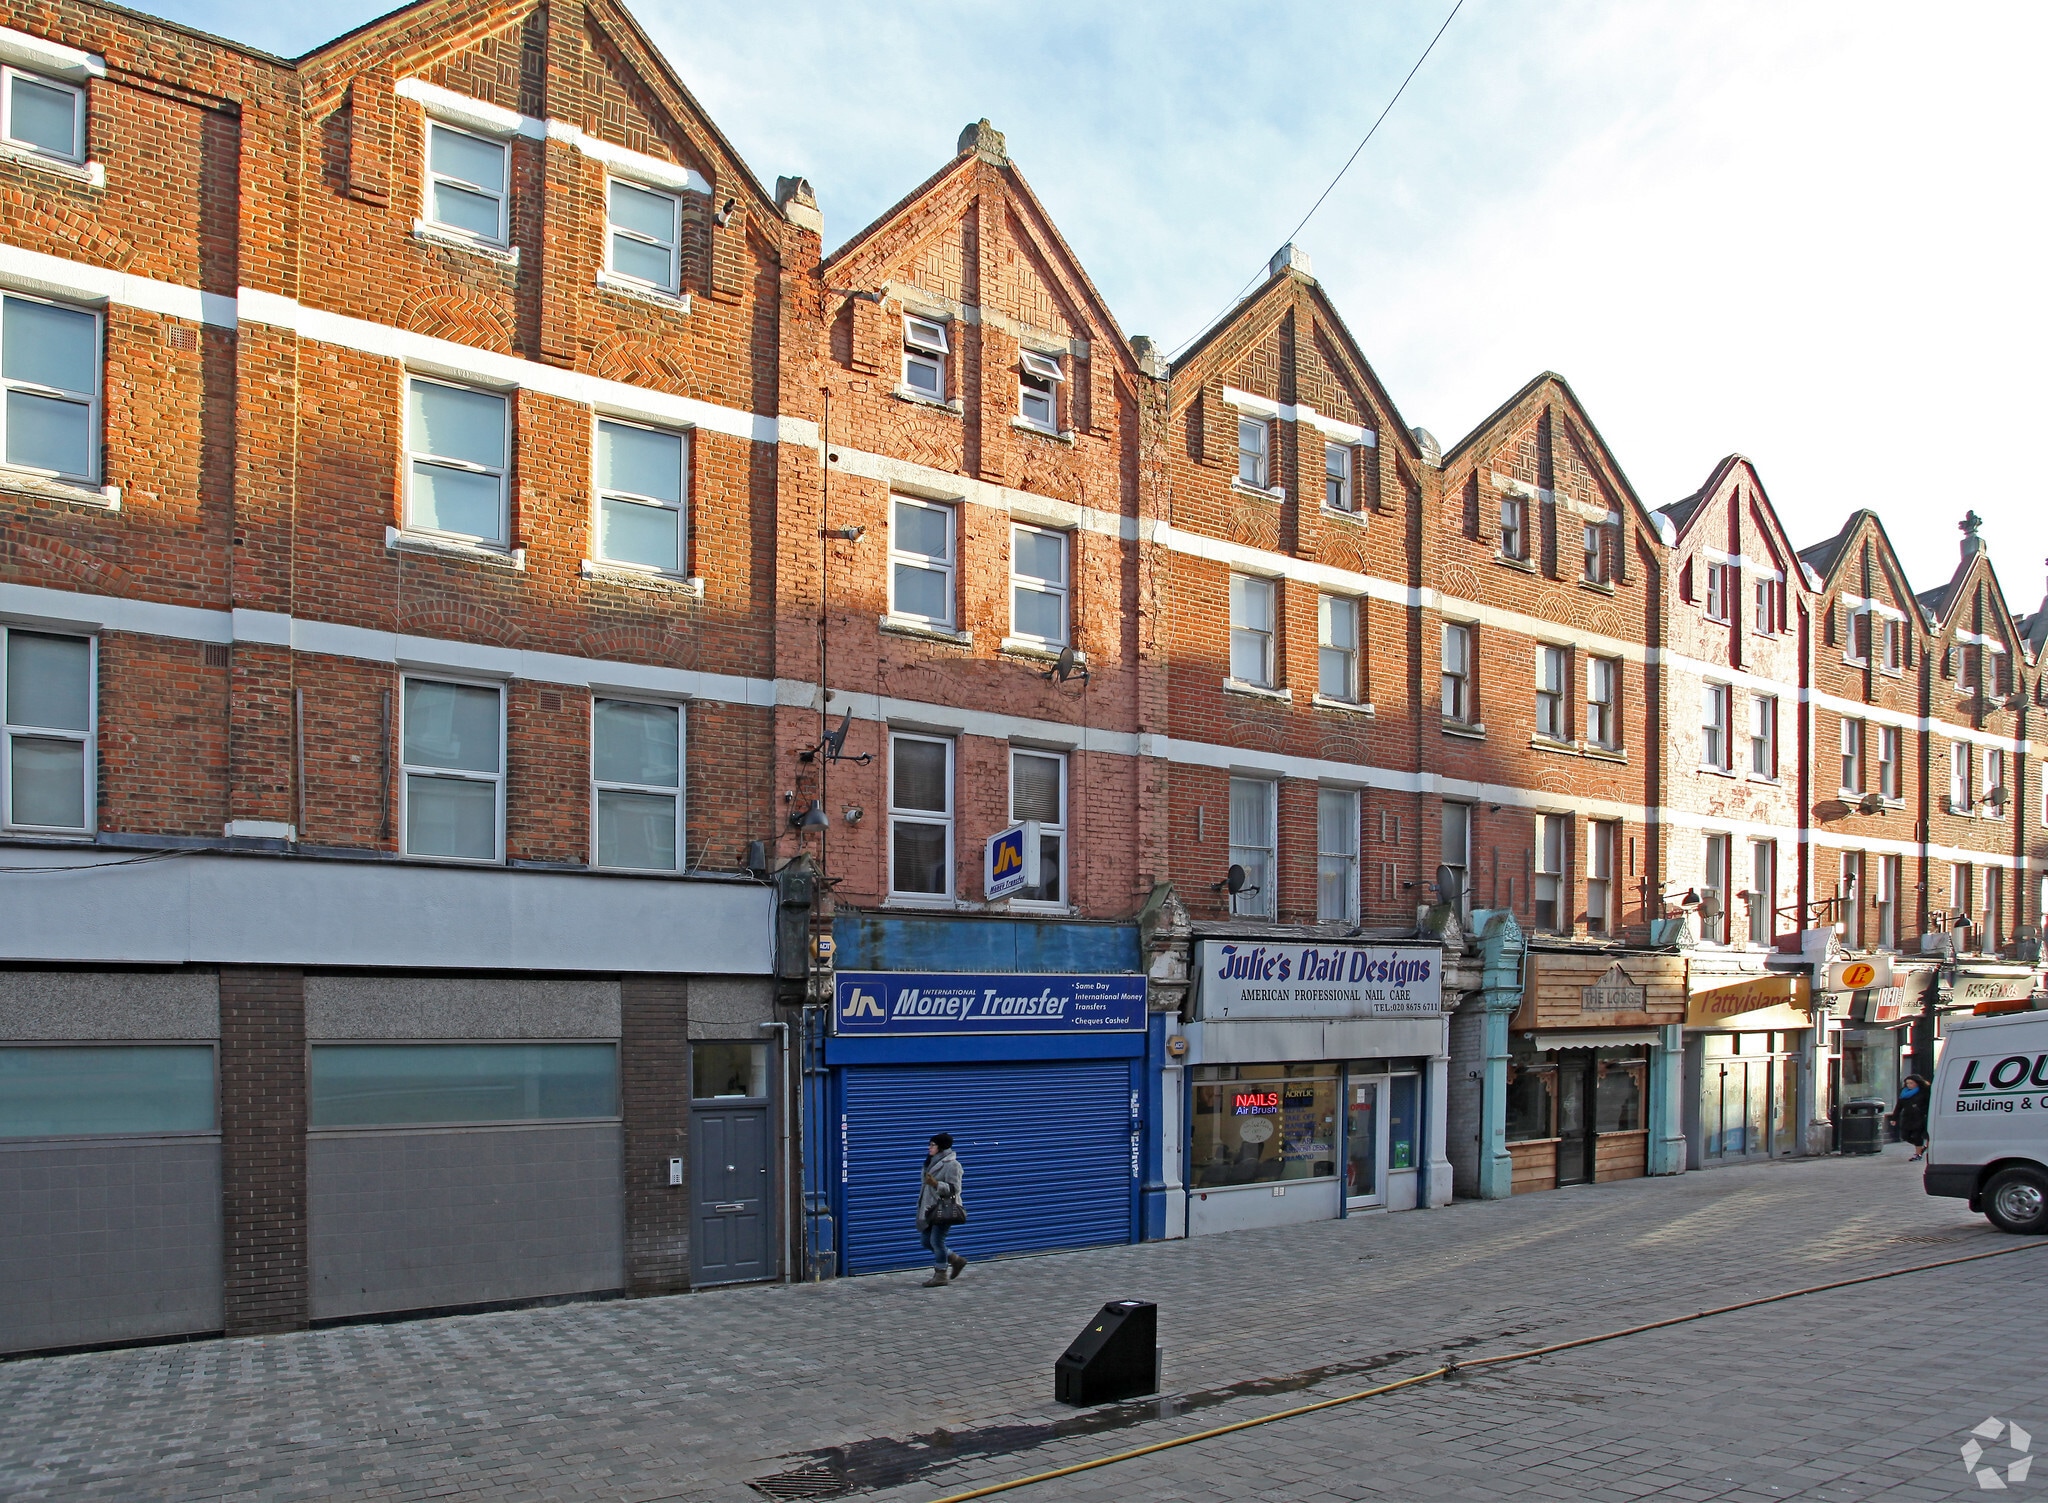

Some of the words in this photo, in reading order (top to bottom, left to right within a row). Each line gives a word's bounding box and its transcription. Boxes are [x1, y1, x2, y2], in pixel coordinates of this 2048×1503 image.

[990, 881, 1006, 895] Money
[1006, 875, 1025, 889] Transfer
[1218, 945, 1291, 982] Julie's
[1298, 948, 1346, 982] Nail
[1349, 951, 1431, 988] Designs
[1075, 982, 1094, 990] Same
[1096, 982, 1110, 991] Day
[1120, 993, 1143, 1001] Money
[1241, 989, 1290, 1001] AMERICAN
[1295, 989, 1360, 1001] PROFESSIONAL
[1365, 989, 1385, 1001] NAIL
[1389, 989, 1411, 1001] CARE
[1584, 992, 1603, 1004] THE
[1607, 991, 1641, 1004] LODGE
[893, 989, 976, 1021] Money
[981, 987, 1069, 1015] Transfer
[1405, 1003, 1421, 1011] 8675
[1422, 1003, 1438, 1011] 6711
[1223, 1007, 1229, 1017] 7
[1075, 1017, 1103, 1026] Cheques
[1285, 1089, 1313, 1098] ACRYLIC
[1236, 1092, 1279, 1107] NAILS
[1350, 1103, 1371, 1112] OPEN
[1956, 1098, 2014, 1113] Building
[2021, 1097, 2032, 1110] &
[1236, 1106, 1248, 1115] Air
[1252, 1106, 1277, 1115] Brush
